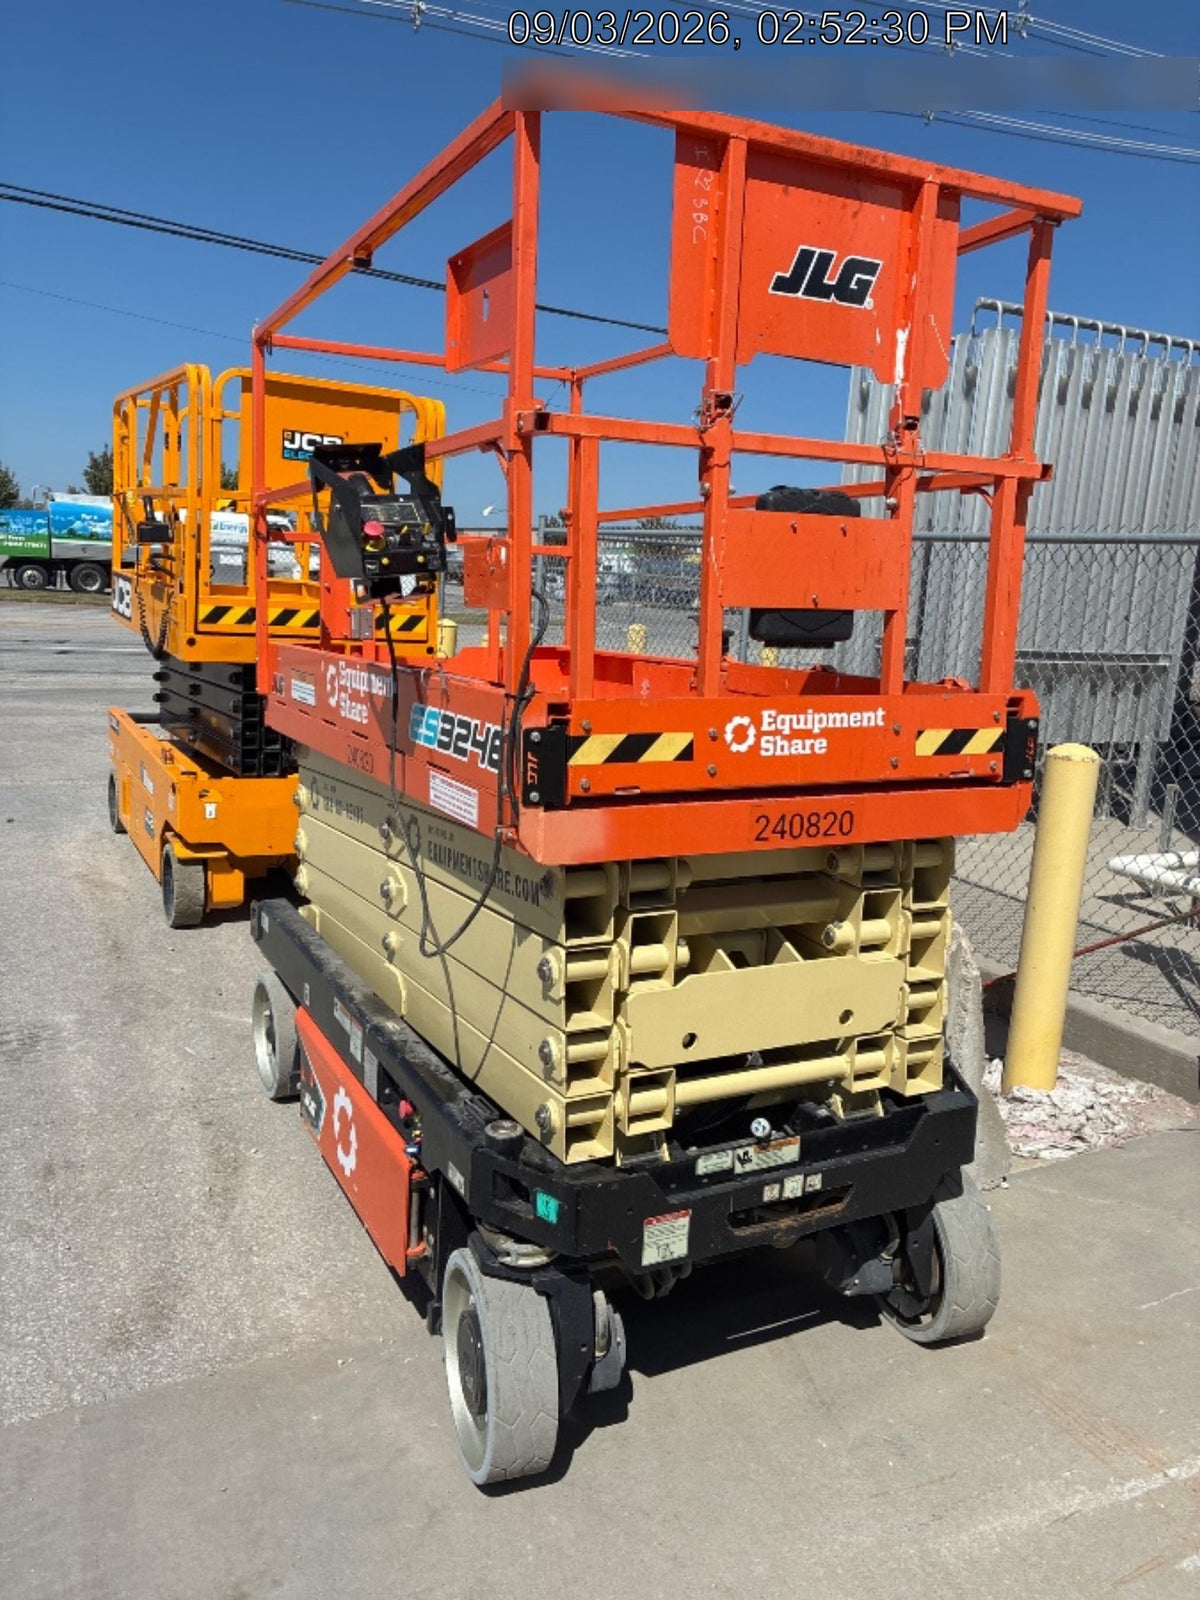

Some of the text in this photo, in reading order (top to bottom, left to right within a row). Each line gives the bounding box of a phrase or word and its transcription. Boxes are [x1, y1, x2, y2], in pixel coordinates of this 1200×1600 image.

[768, 244, 884, 309] JLG
[339, 660, 397, 698] Equipmen
[340, 691, 369, 724] Share
[760, 706, 886, 736] Equipment
[760, 734, 828, 757] Share
[754, 810, 855, 841] 240820
